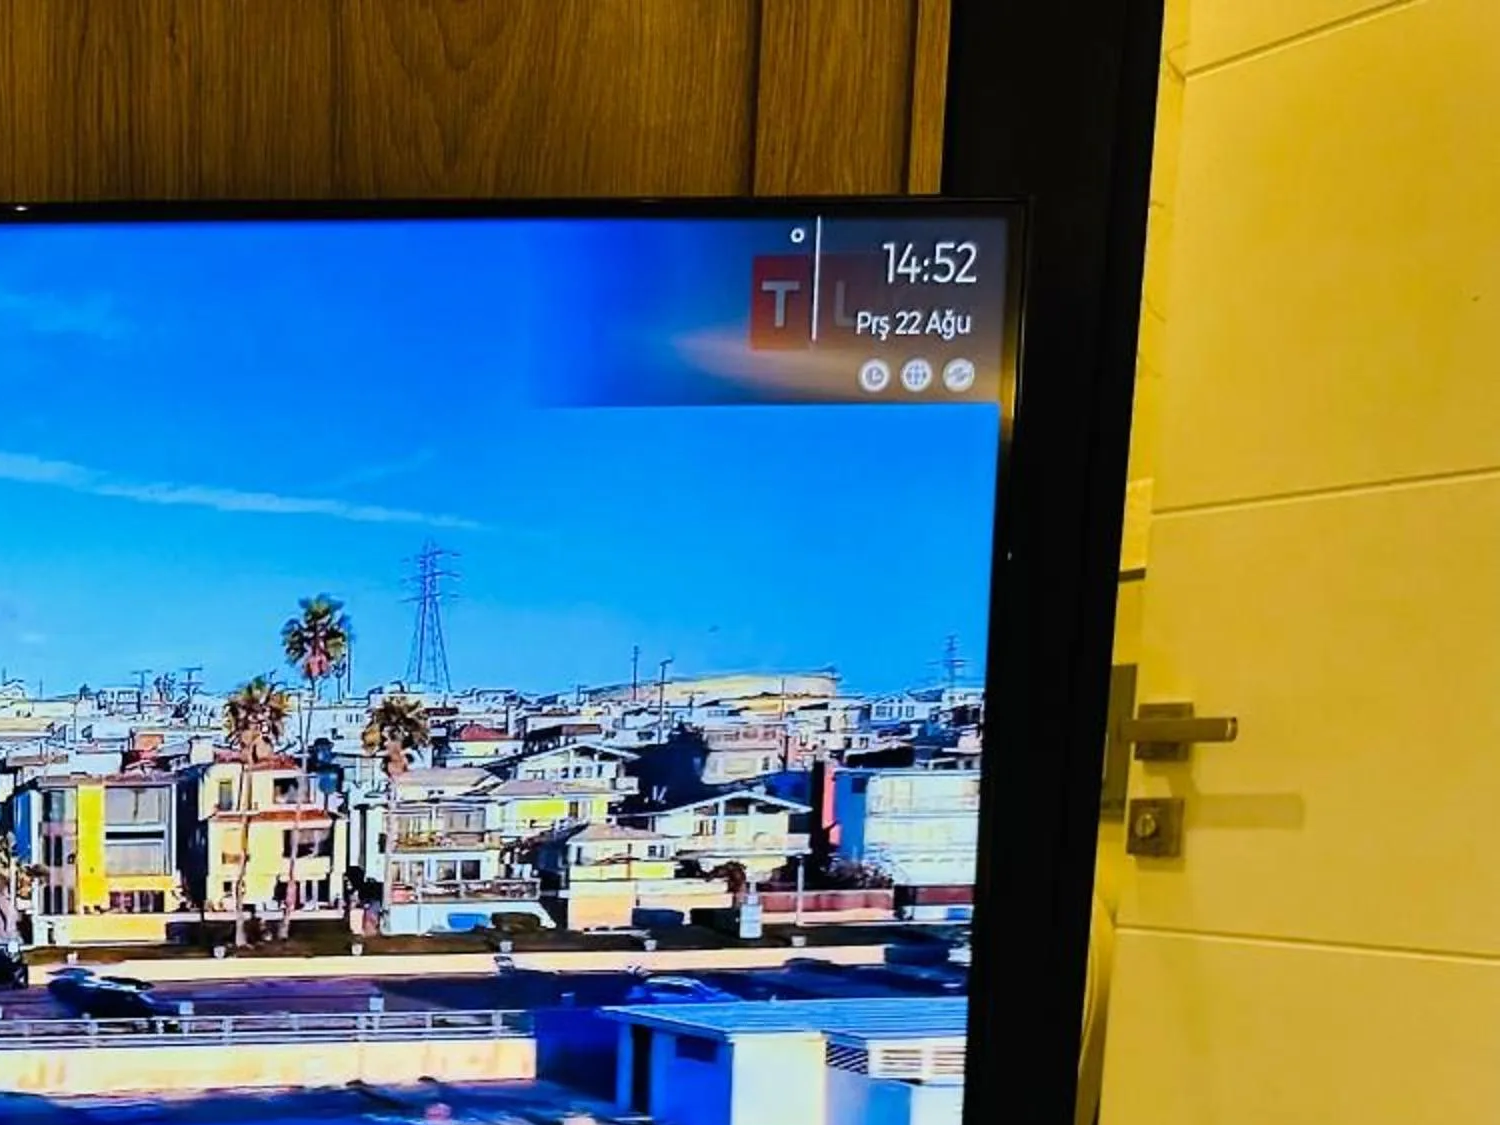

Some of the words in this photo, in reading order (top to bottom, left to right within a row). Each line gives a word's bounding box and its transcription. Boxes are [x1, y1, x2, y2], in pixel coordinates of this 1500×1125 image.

[883, 241, 978, 284] 14:52
[856, 310, 891, 340] Prş
[895, 311, 922, 335] 22
[925, 309, 971, 340] Ağu
